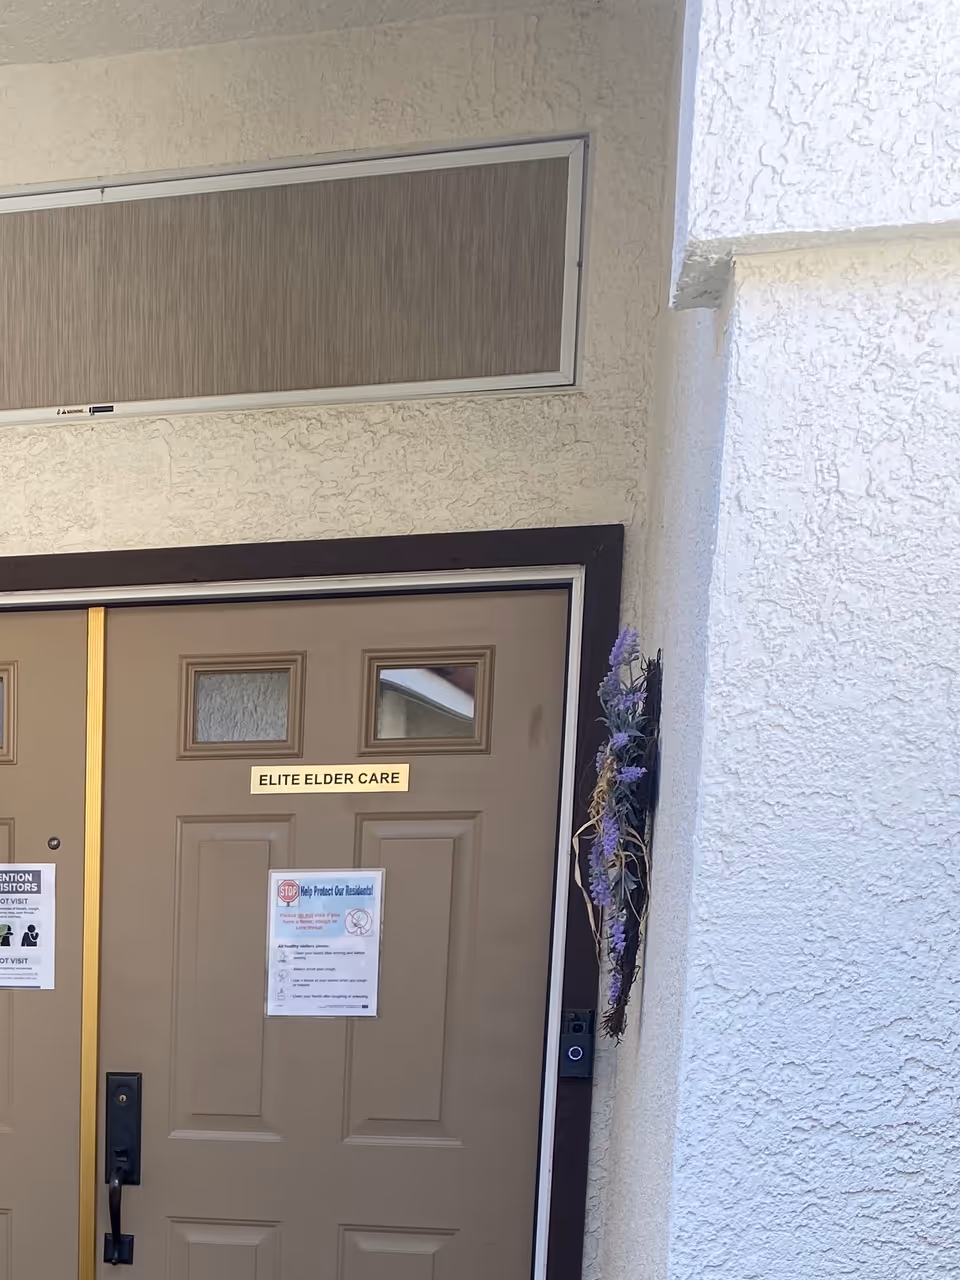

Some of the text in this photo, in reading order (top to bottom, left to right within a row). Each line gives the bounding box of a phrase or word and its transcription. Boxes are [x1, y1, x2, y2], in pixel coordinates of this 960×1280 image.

[259, 772, 400, 786] ELITE ELDER CARE
[280, 886, 298, 897] STOP
[300, 884, 374, 899] Help Protect Our Residents!
